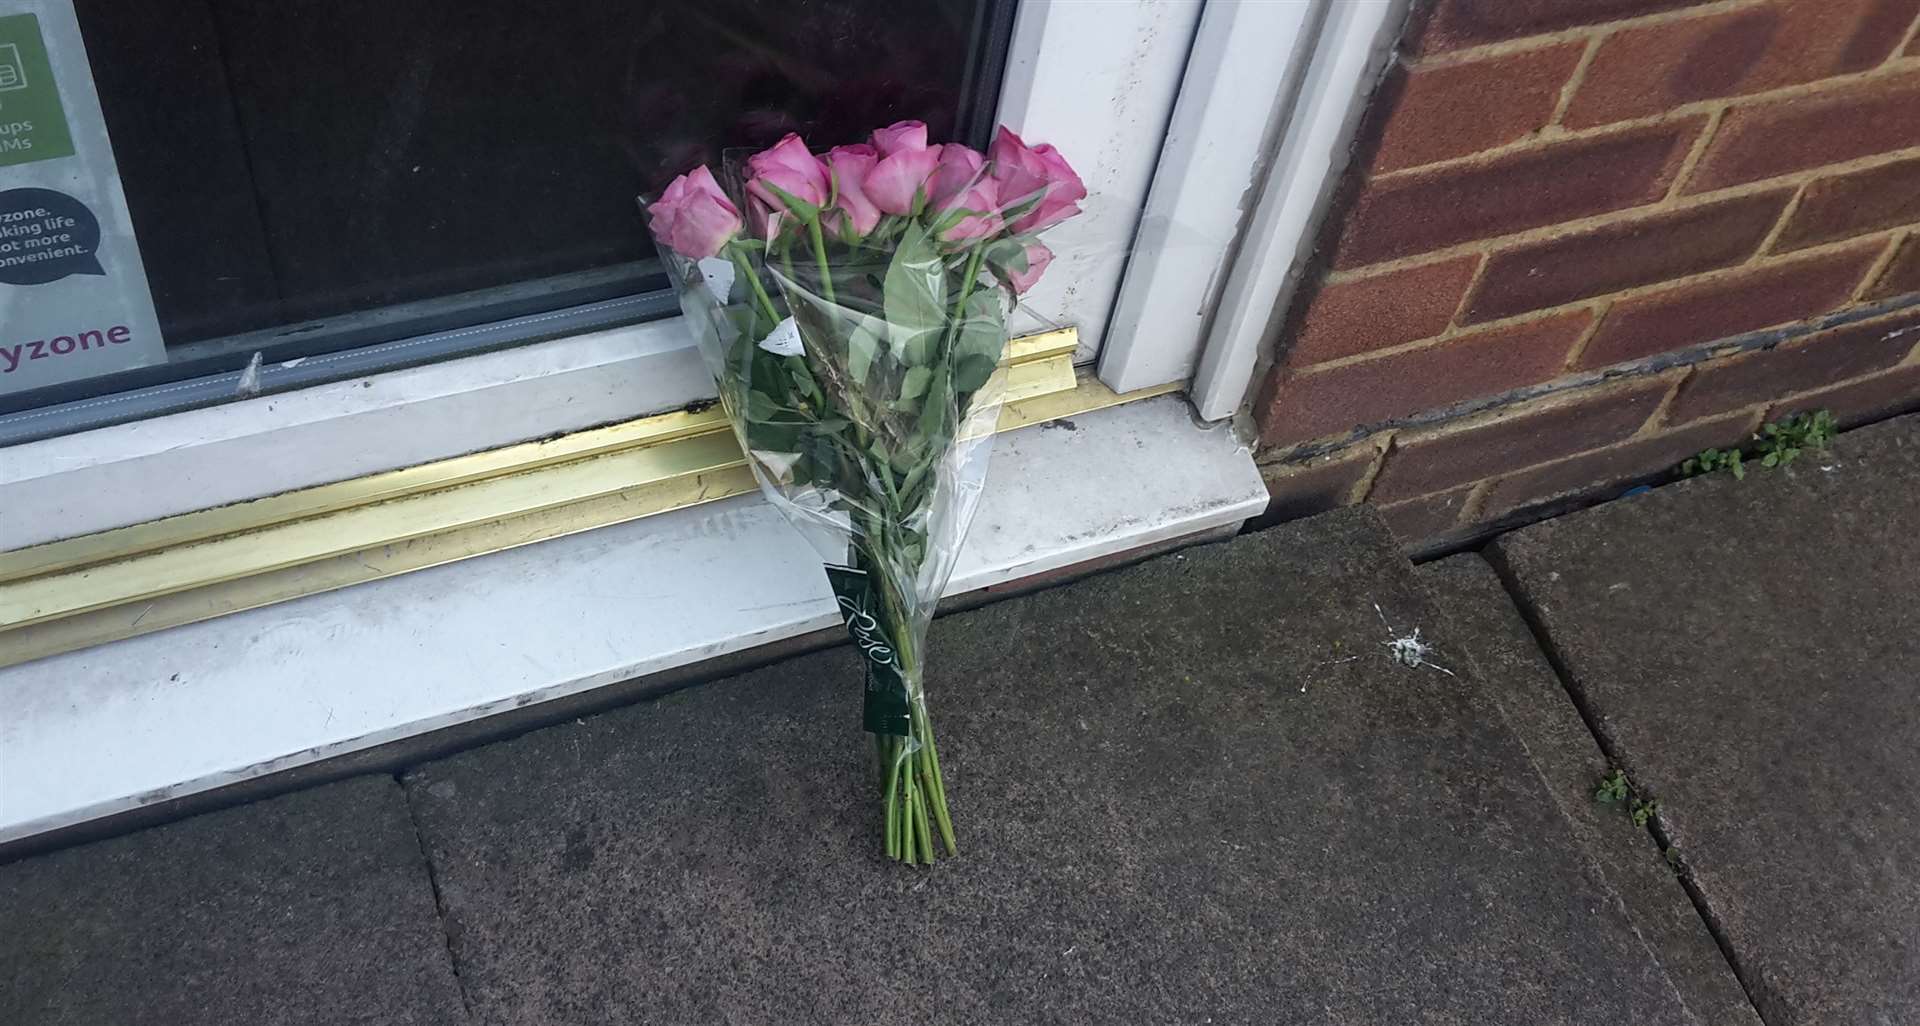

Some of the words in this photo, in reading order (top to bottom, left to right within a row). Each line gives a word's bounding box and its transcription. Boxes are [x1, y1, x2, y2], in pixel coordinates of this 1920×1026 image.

[0, 121, 32, 135] ups
[0, 208, 51, 222] zone.
[0, 223, 42, 238] king
[44, 216, 75, 230] life
[0, 241, 21, 253] ot
[24, 233, 71, 248] more
[0, 325, 131, 374] yzone
